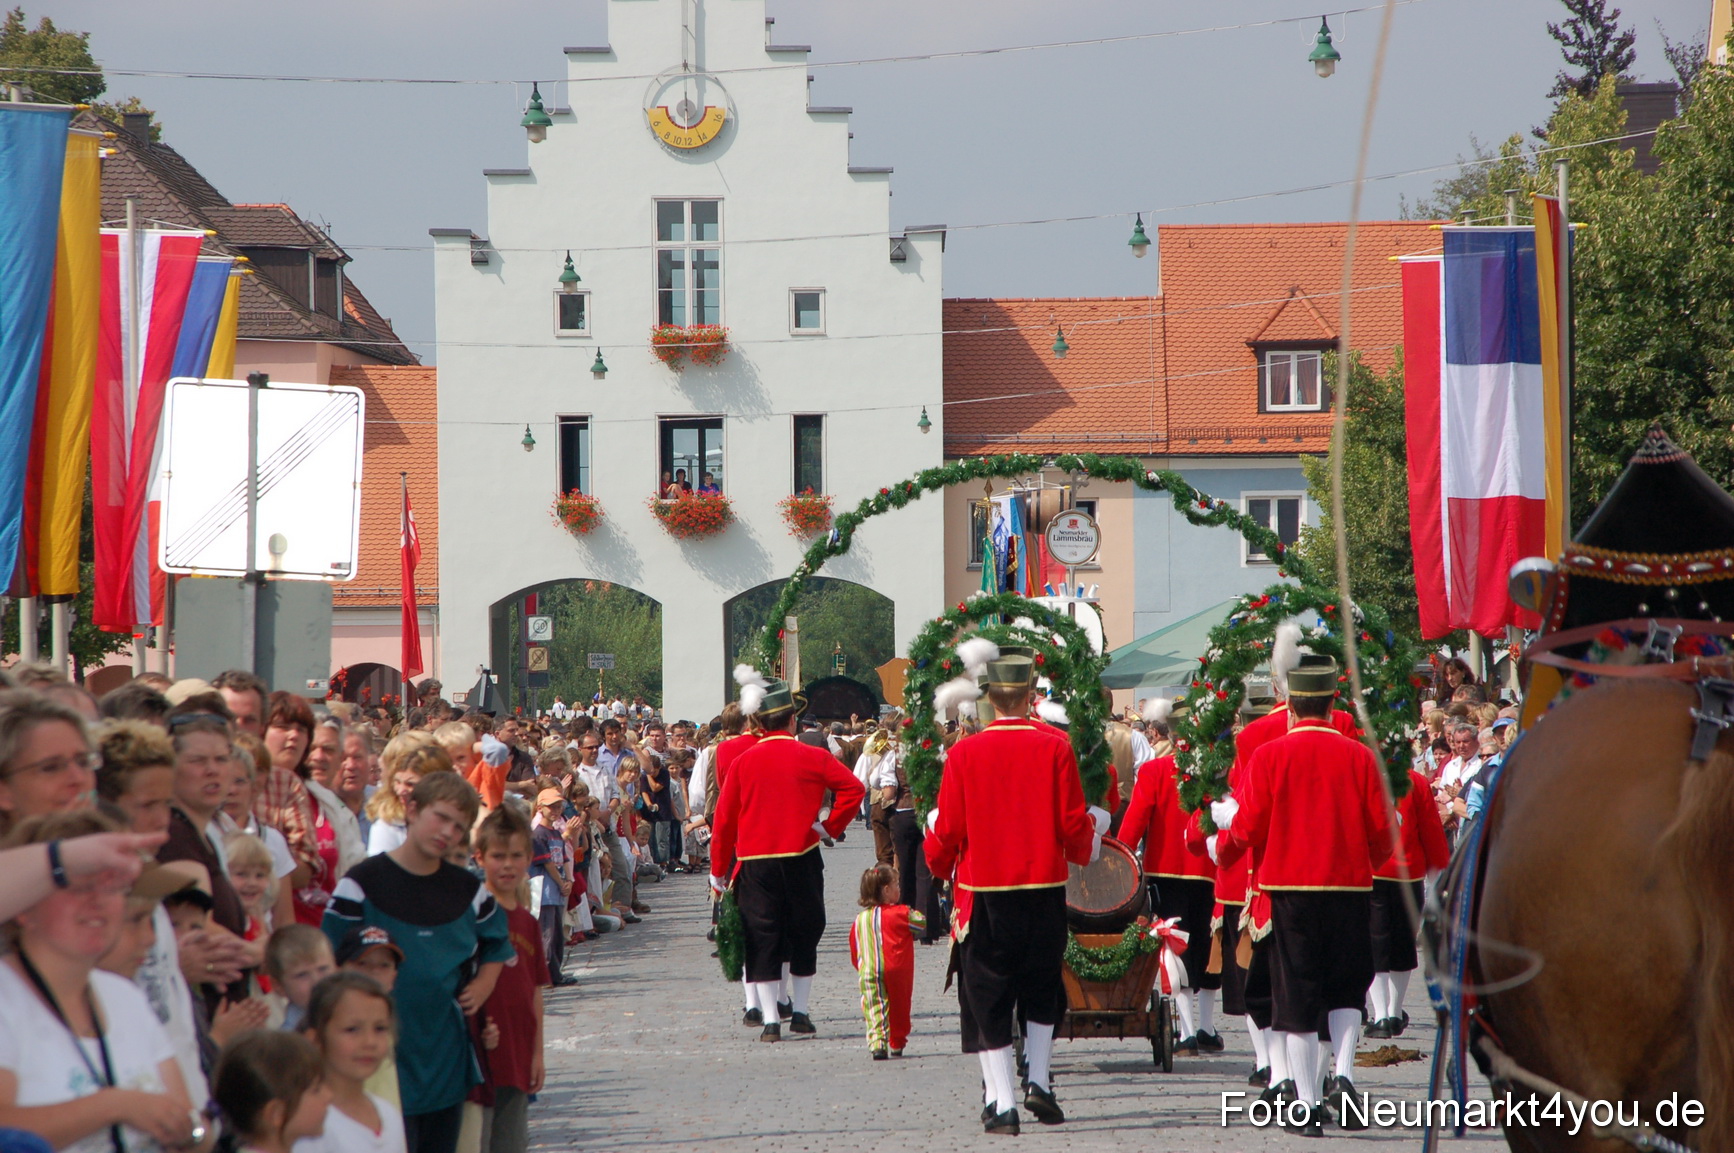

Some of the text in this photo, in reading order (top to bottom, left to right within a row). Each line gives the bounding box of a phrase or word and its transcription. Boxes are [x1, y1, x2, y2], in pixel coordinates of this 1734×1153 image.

[673, 135, 682, 145] 10
[683, 137, 693, 146] 12
[714, 114, 722, 122] 16
[1053, 534, 1093, 542] Lammsbräu
[536, 622, 545, 630] 30
